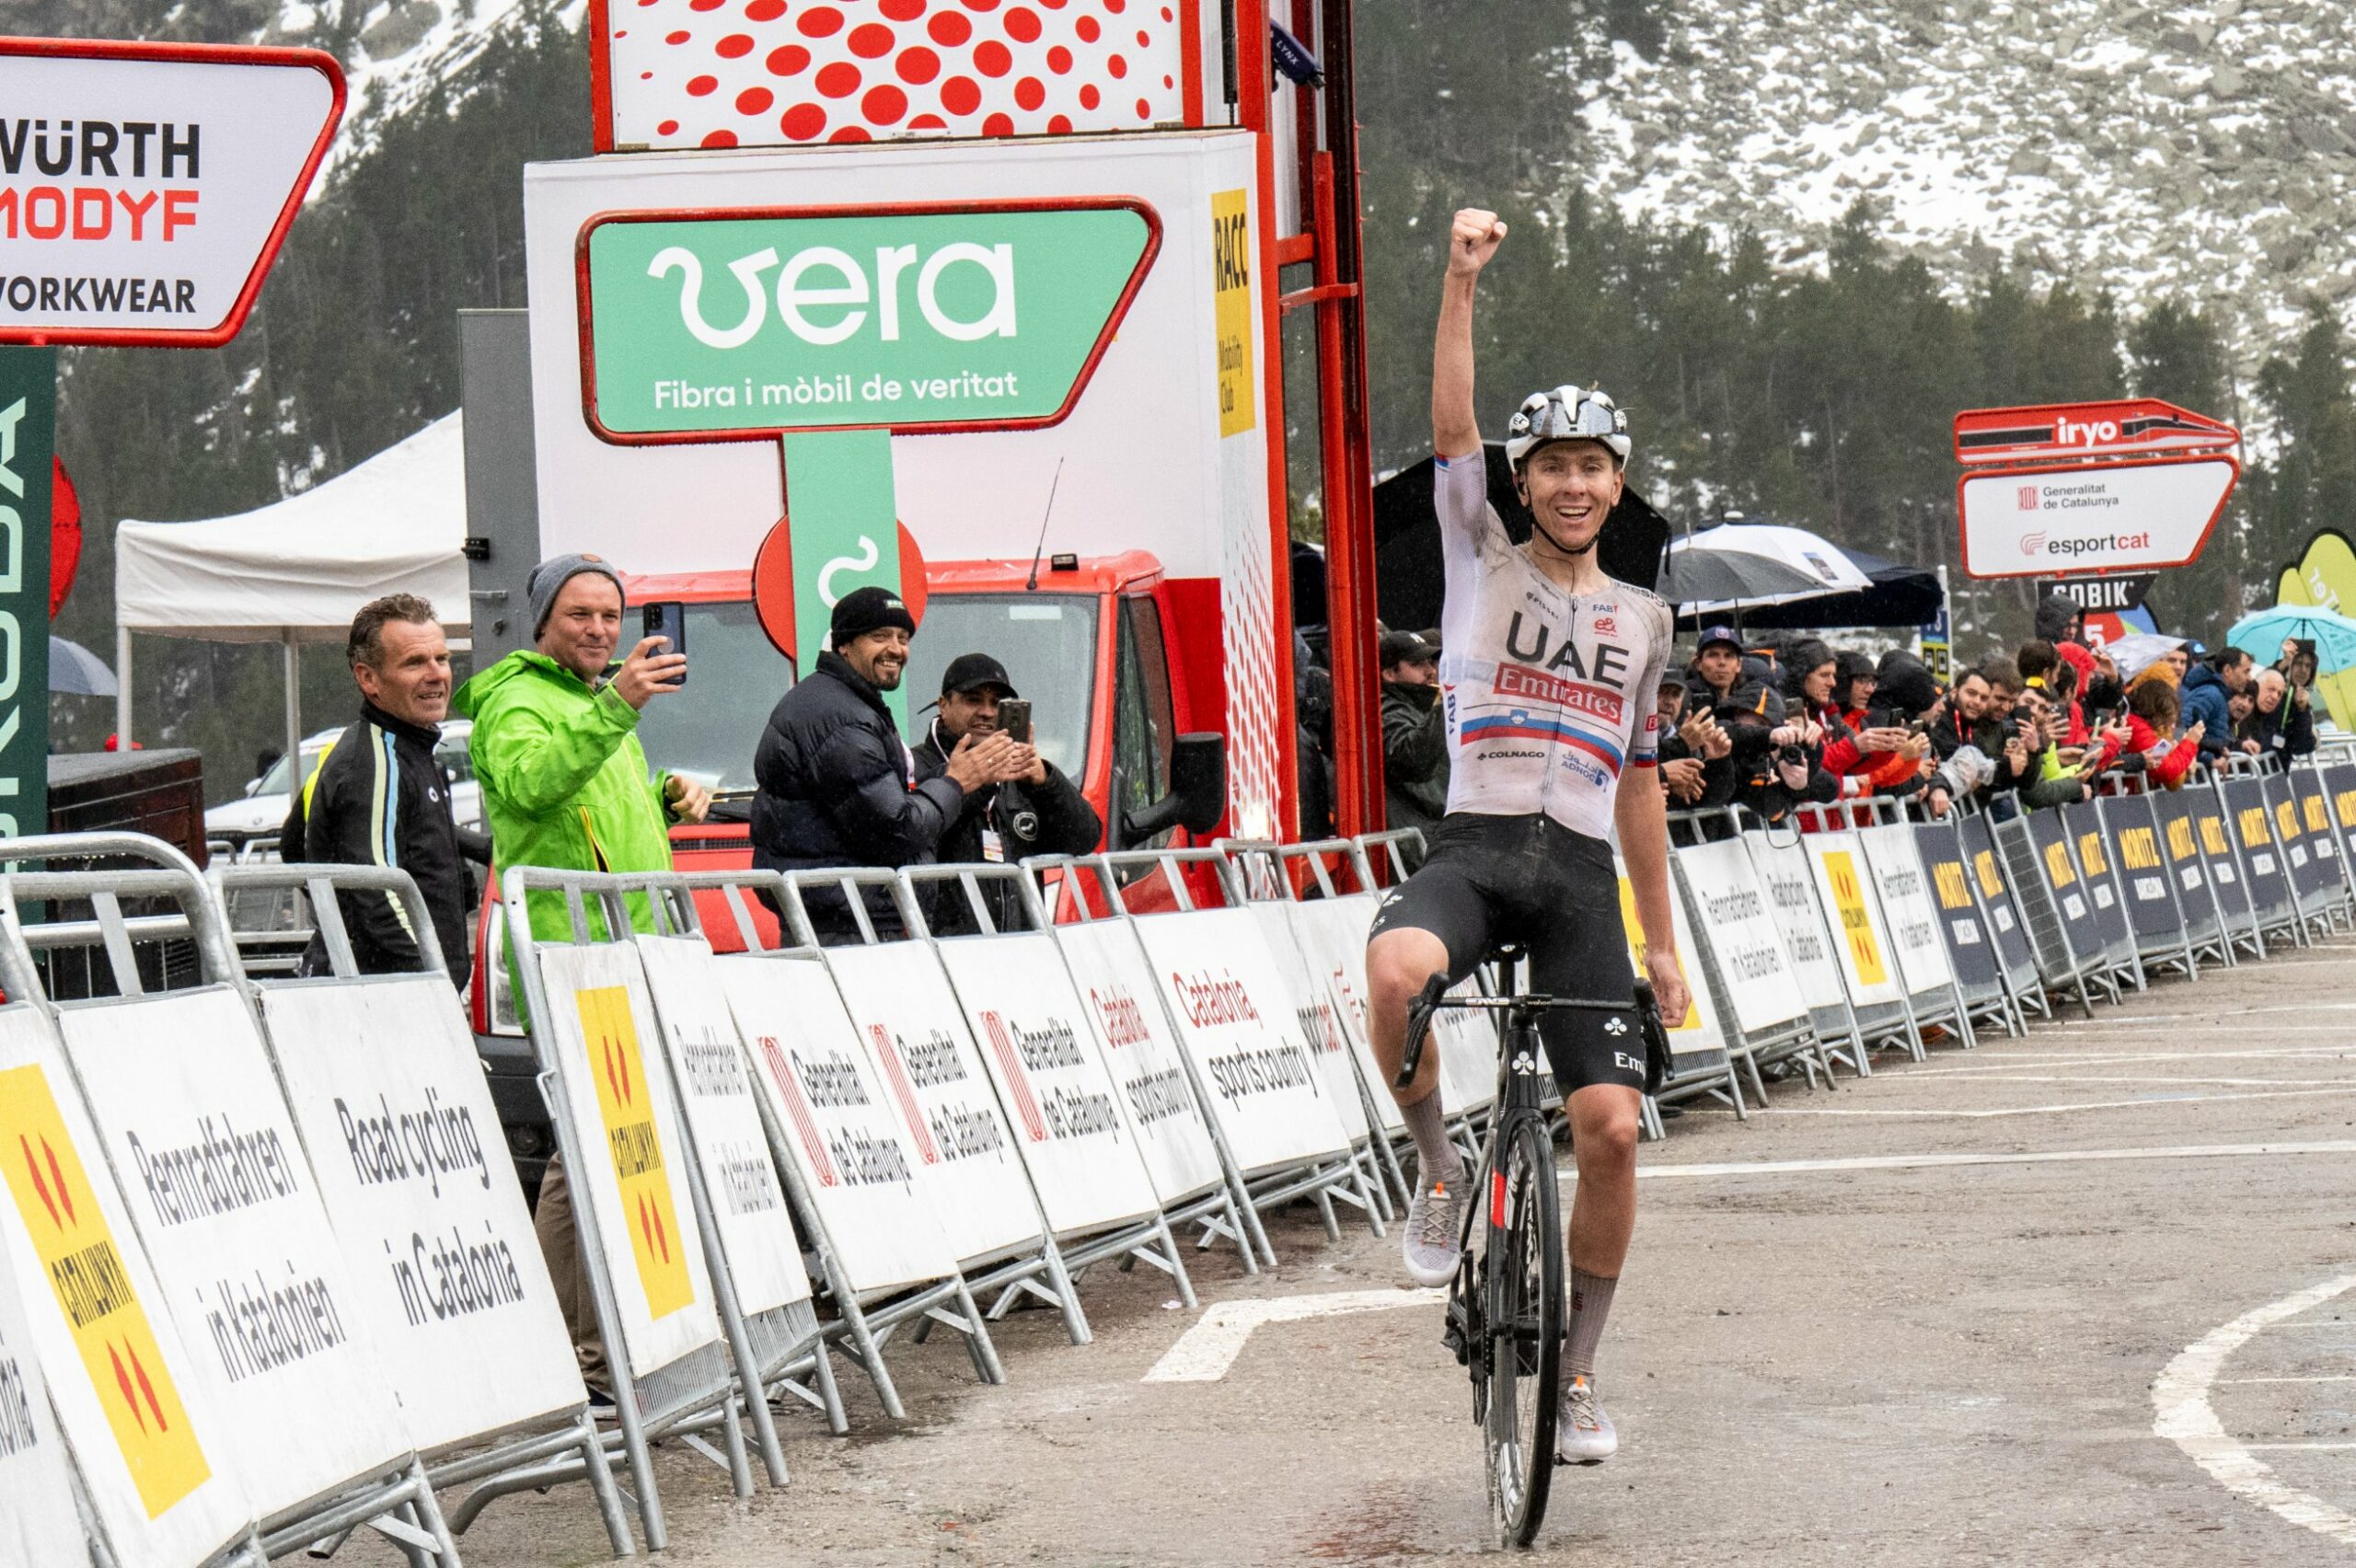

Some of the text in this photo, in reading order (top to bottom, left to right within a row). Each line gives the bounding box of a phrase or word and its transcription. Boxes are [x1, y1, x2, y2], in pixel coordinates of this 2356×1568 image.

[1276, 40, 1299, 65] LYNX
[1215, 213, 1248, 293] RACC
[0, 276, 196, 313] ORKWEAR
[647, 242, 1017, 350] vera
[654, 370, 1019, 409] Fibra i mòbil de veritat
[2057, 417, 2118, 449] iryo
[2043, 484, 2106, 497] Generalitat
[2043, 496, 2119, 510] de Catalunya
[2048, 532, 2150, 557] esportcat
[1593, 604, 1613, 613] FAB
[1507, 611, 1629, 689] UAE
[1499, 666, 1621, 721] Emirates
[1488, 751, 1545, 759] COLNAGO
[1561, 760, 1597, 781] ADNOC
[896, 1029, 967, 1089] Generalitat
[1011, 1017, 1085, 1072] Generalitat
[791, 1049, 871, 1108] Generalitat
[1208, 1036, 1318, 1113] sports country
[334, 1086, 491, 1199] Road cycling
[929, 1101, 1004, 1163] de Catalunya
[1041, 1085, 1120, 1144] de Catalunya
[125, 1112, 298, 1228] Rennradfahren
[610, 1121, 661, 1180] CATALUNYA
[827, 1125, 912, 1197] de Catalunya
[51, 1240, 134, 1330] CATALUNYA
[385, 1220, 525, 1327] in Catalonia
[196, 1260, 346, 1384] in Katalonien
